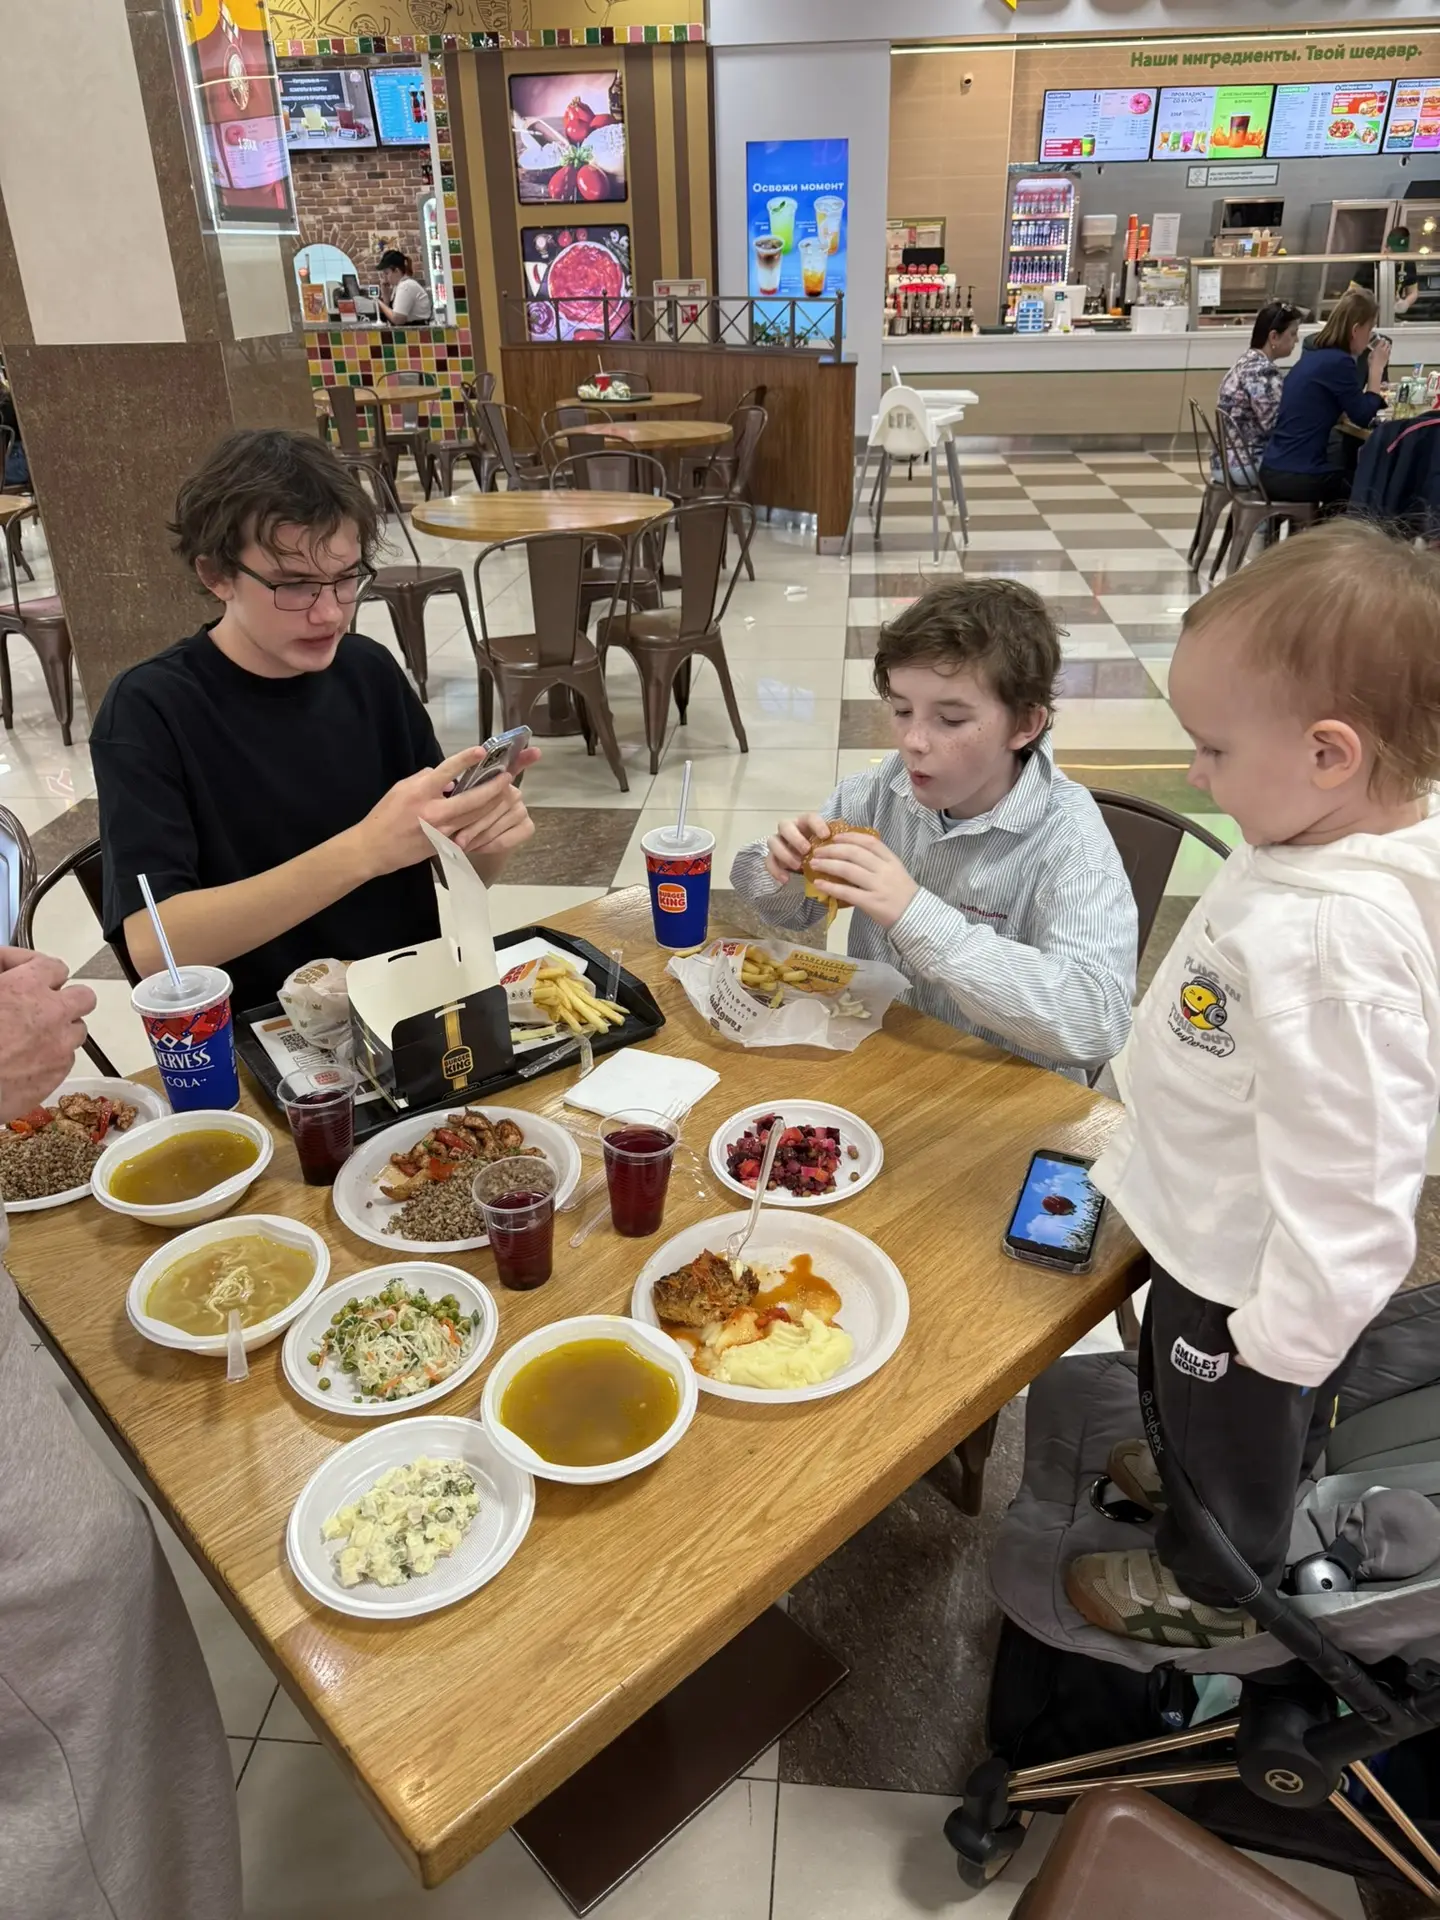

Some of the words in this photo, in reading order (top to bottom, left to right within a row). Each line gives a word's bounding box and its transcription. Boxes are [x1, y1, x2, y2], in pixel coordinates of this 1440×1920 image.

[1130, 52, 1178, 67] Наши
[1182, 50, 1302, 69] ингредиенты.
[1305, 44, 1346, 60] Твой
[1349, 44, 1422, 61] шедевр.
[752, 183, 798, 192] Освежи
[800, 182, 844, 191] момент
[659, 891, 685, 899] BURGER
[660, 897, 685, 906] KING
[1200, 1031, 1231, 1047] OUT
[153, 1047, 211, 1069] VERVESS
[444, 1053, 471, 1066] BURGER
[445, 1059, 471, 1074] KING
[166, 1076, 201, 1088] COLA
[1175, 1344, 1220, 1370] SMILEY
[1175, 1354, 1217, 1379] WORLD
[1146, 1407, 1164, 1455] cybex
